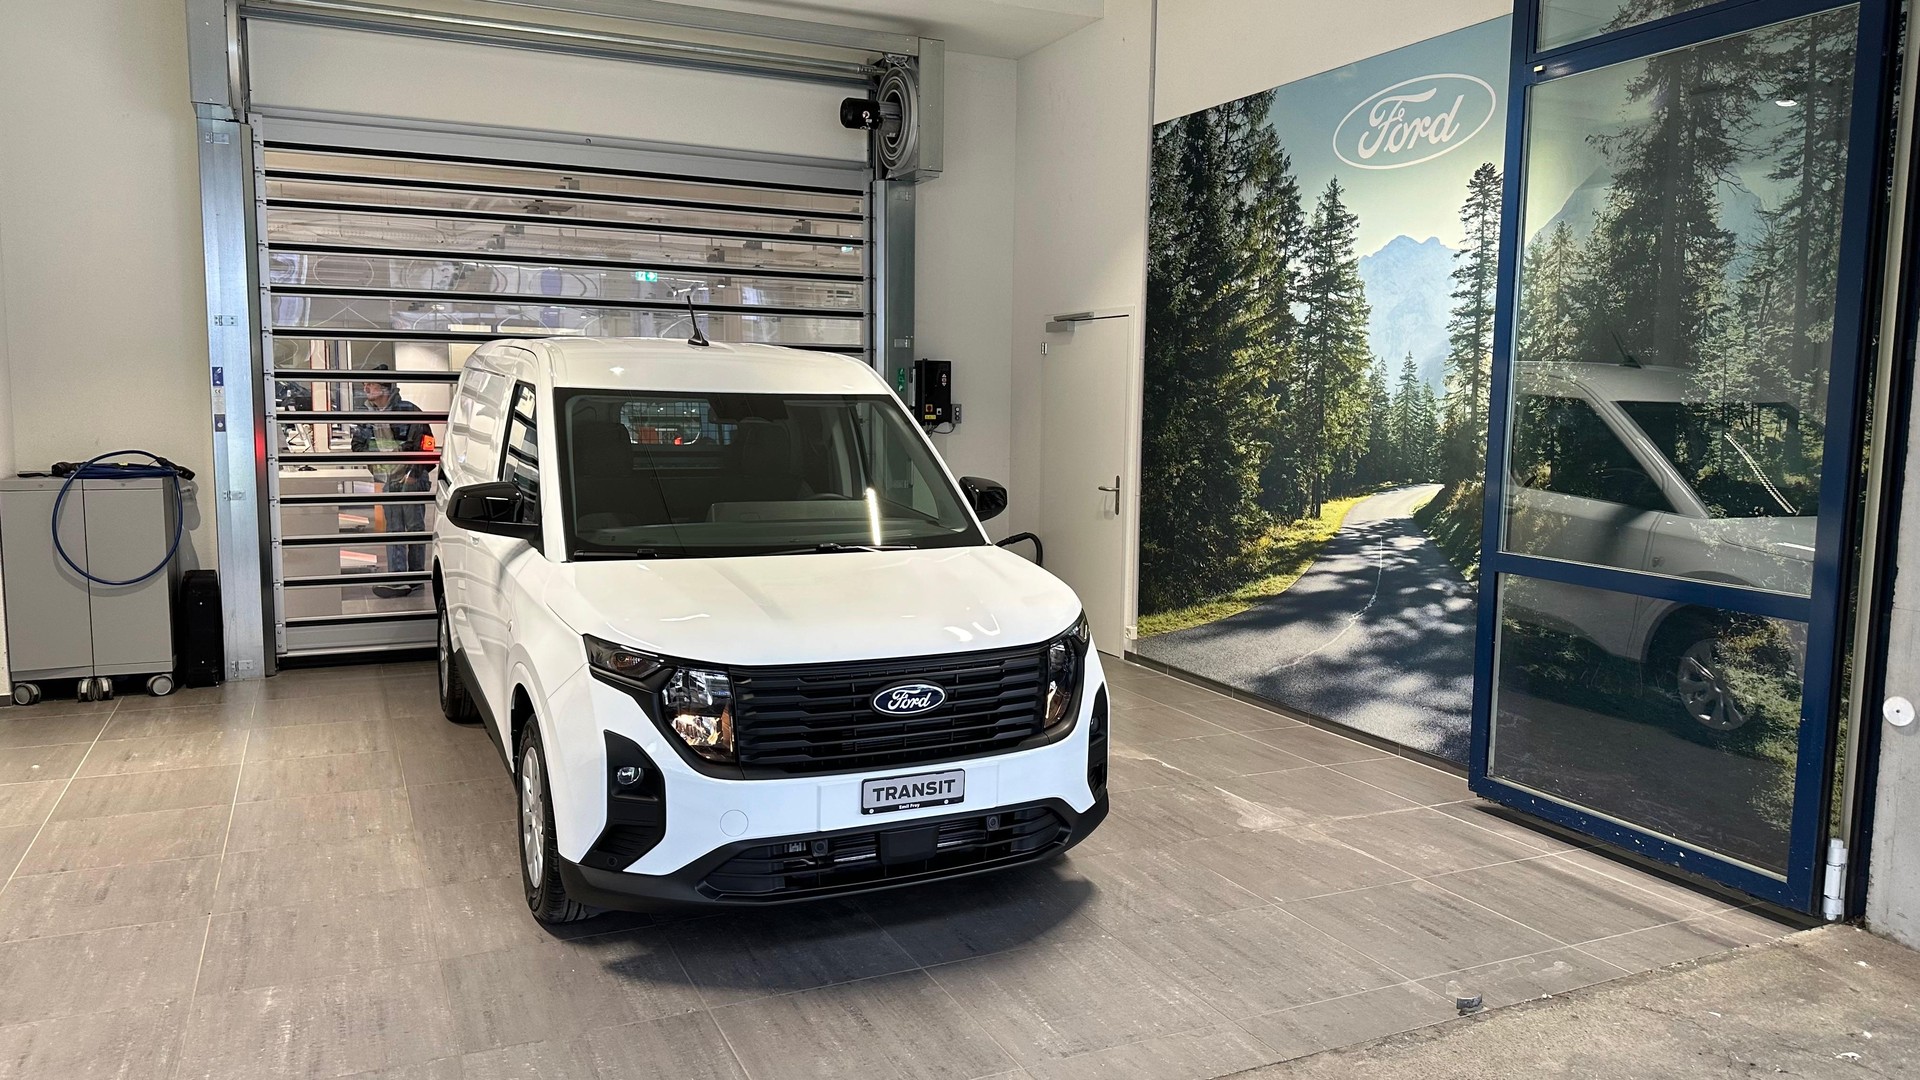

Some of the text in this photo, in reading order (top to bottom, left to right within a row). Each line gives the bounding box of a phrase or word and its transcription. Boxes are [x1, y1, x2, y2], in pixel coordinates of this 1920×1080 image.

[1357, 87, 1465, 159] Ford
[887, 689, 932, 710] Ford
[872, 778, 956, 802] TRANSIT
